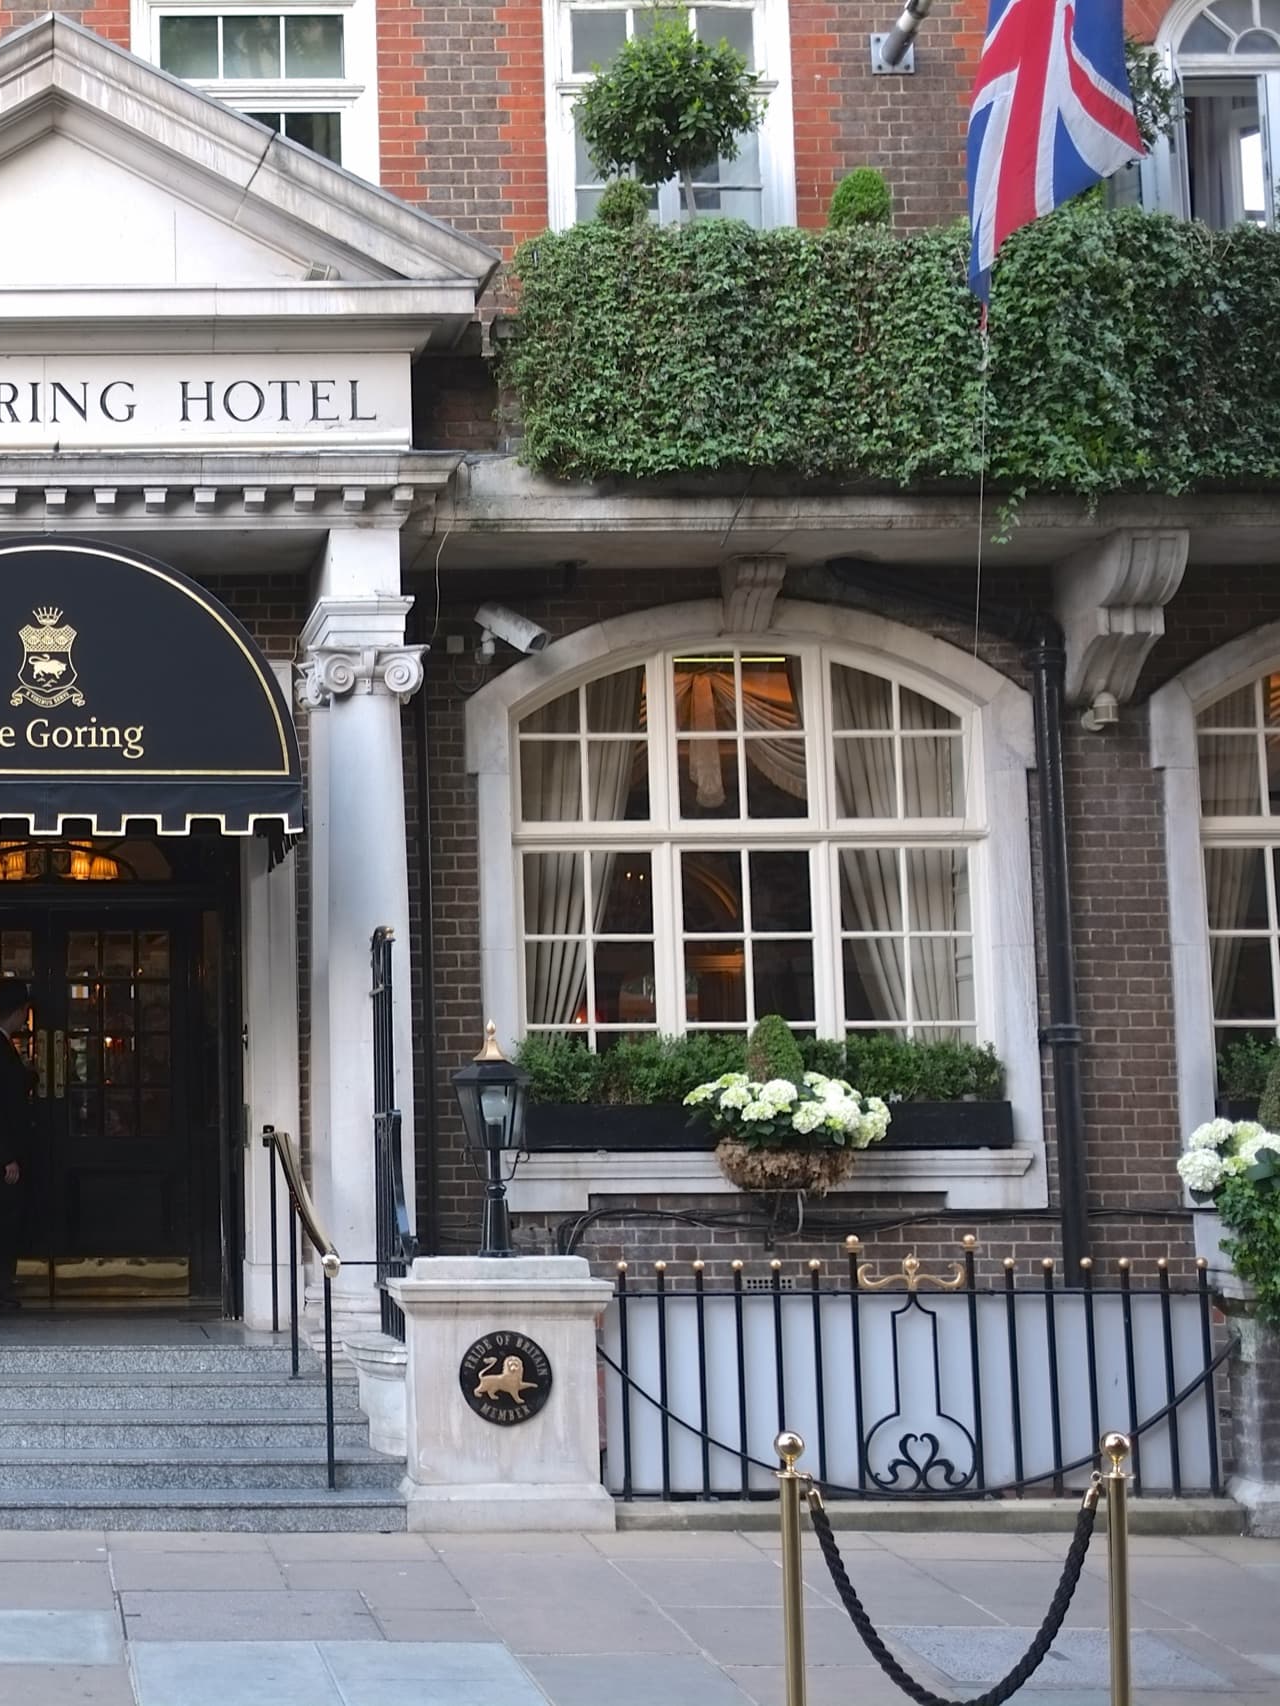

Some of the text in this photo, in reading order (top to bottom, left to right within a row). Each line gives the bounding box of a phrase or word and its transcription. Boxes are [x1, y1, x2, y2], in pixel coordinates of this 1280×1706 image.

[179, 380, 377, 422] HOTEL
[26, 716, 144, 759] Goring
[464, 1335, 548, 1376] PRIDE OF BRITAIN
[480, 1402, 531, 1421] MEMBER
